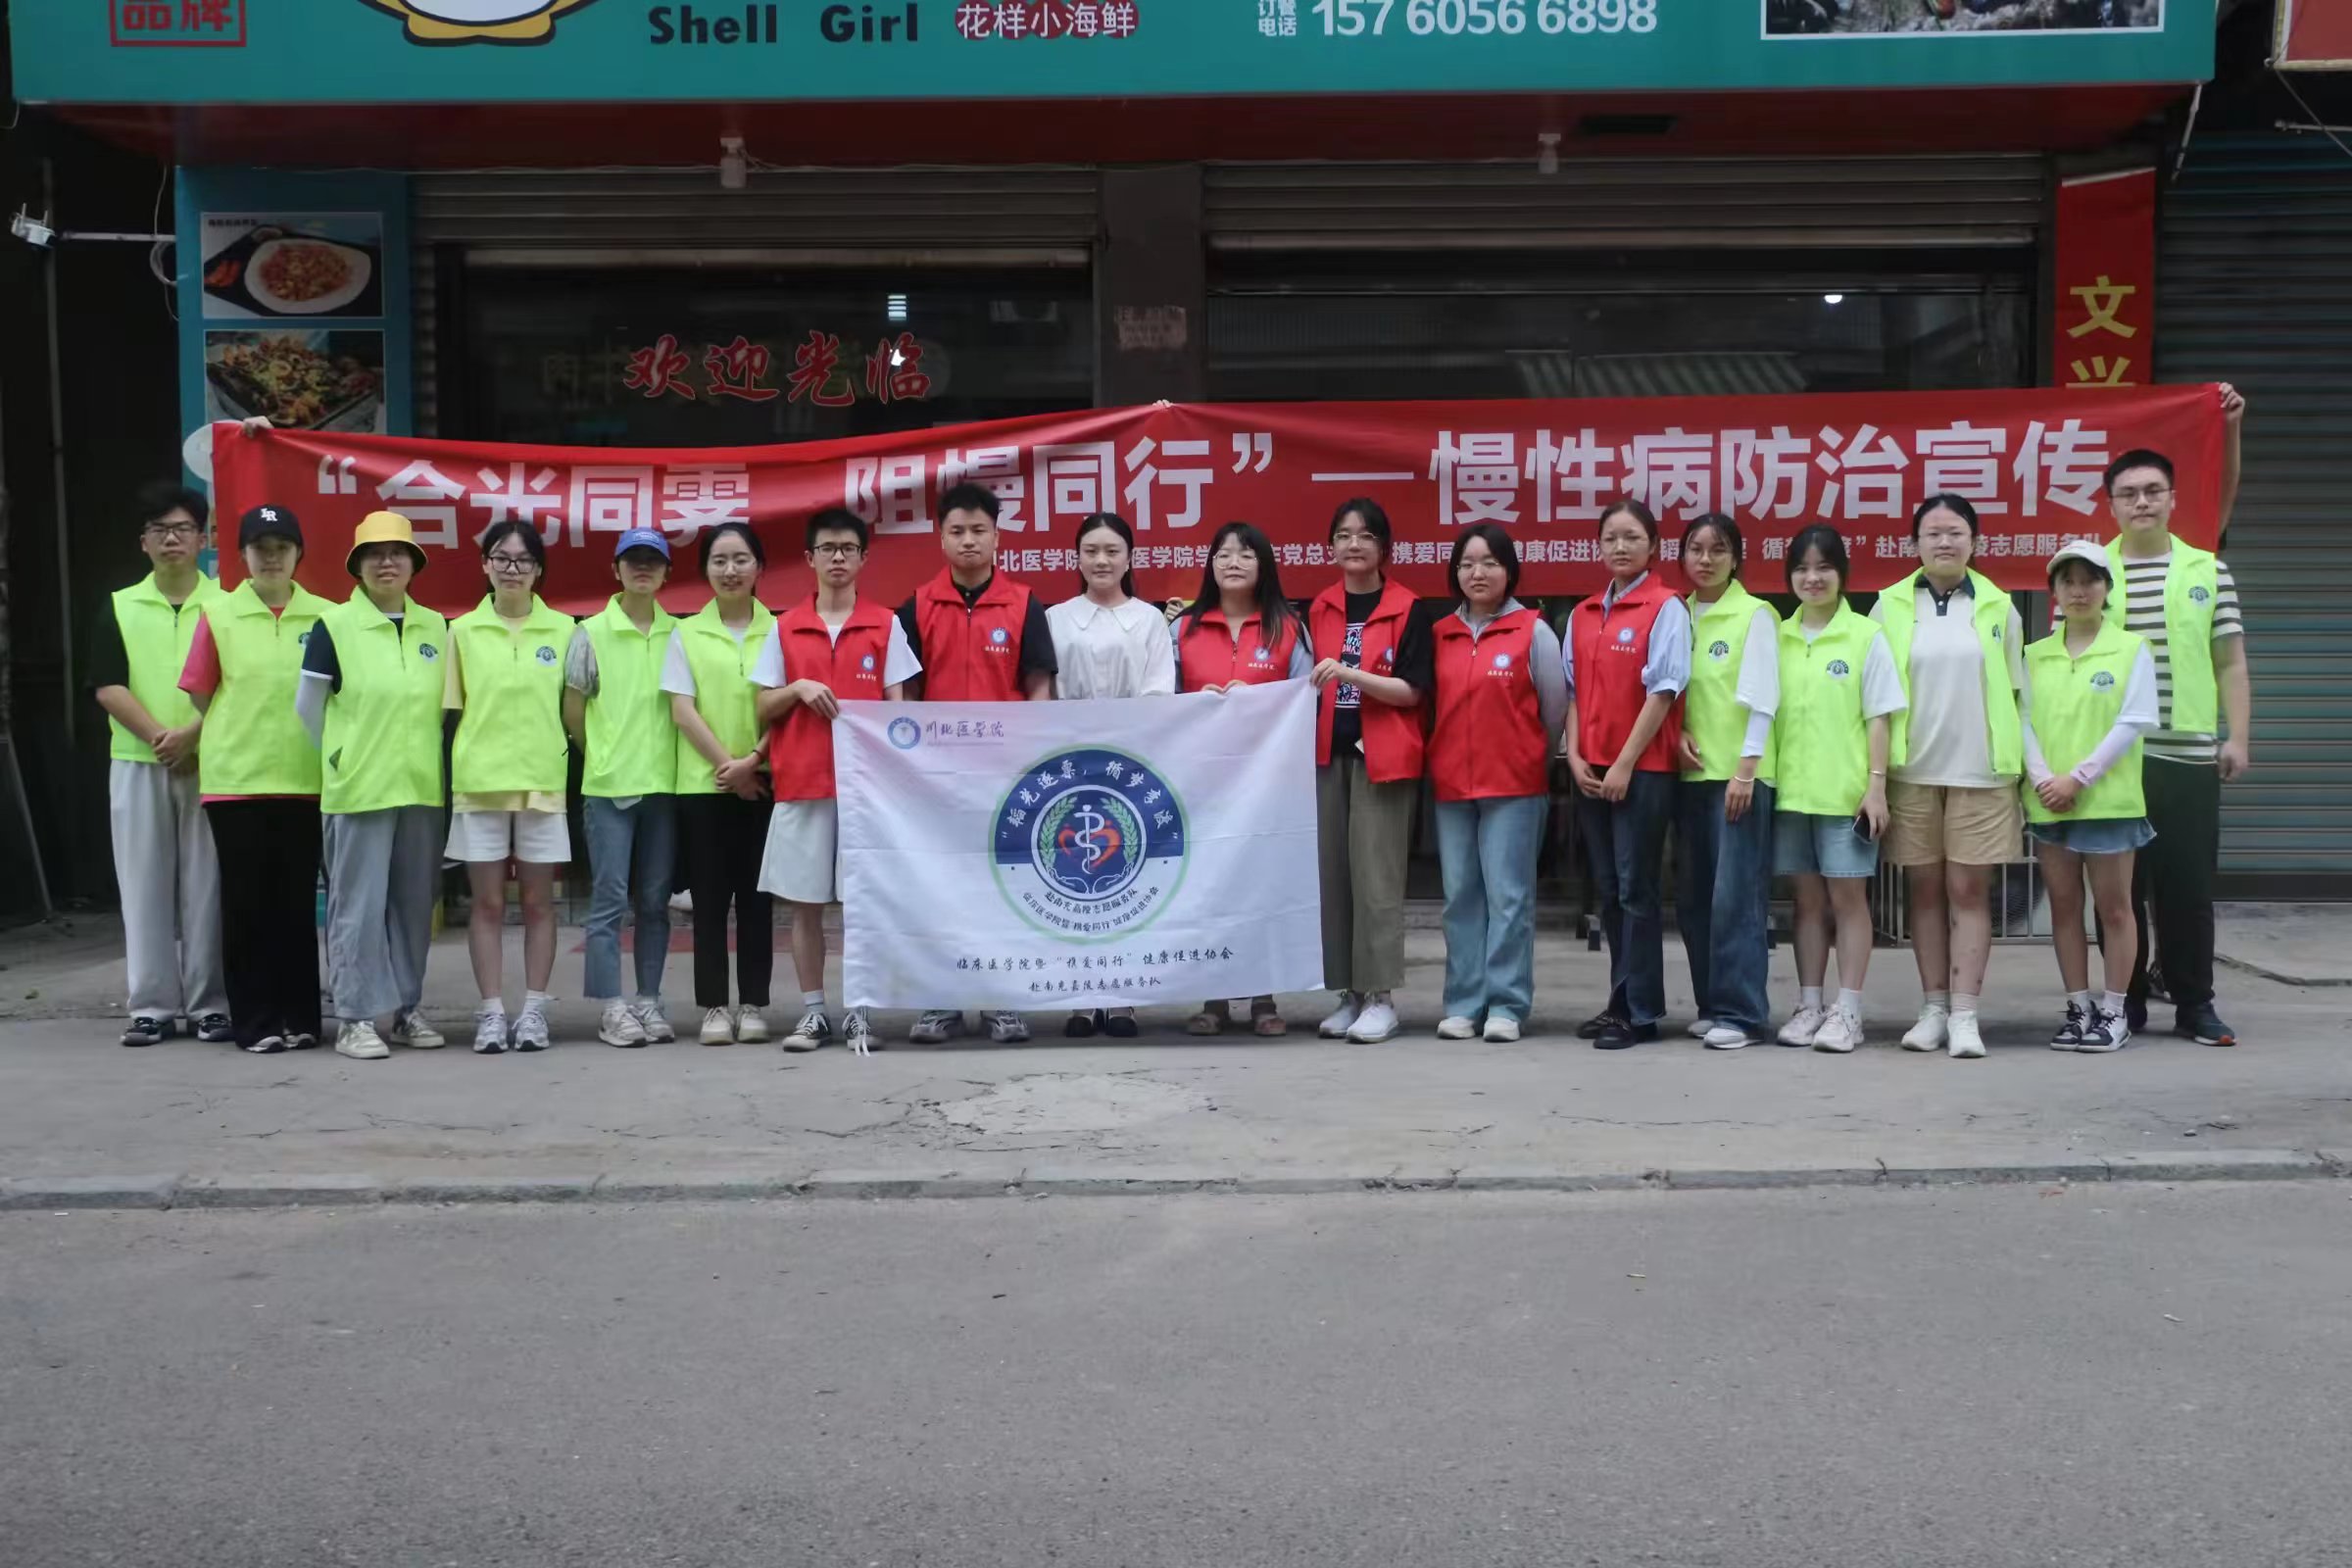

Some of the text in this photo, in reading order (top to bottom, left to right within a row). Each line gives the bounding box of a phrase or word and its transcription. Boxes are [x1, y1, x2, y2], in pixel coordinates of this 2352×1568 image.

[648, 3, 919, 44] Shell Girl
[956, 2, 1137, 39] 花样小海鲜
[1258, 17, 1298, 36] 电话
[1312, 0, 1657, 35] 157 6056 6898
[622, 330, 931, 407] 欢迎光临
